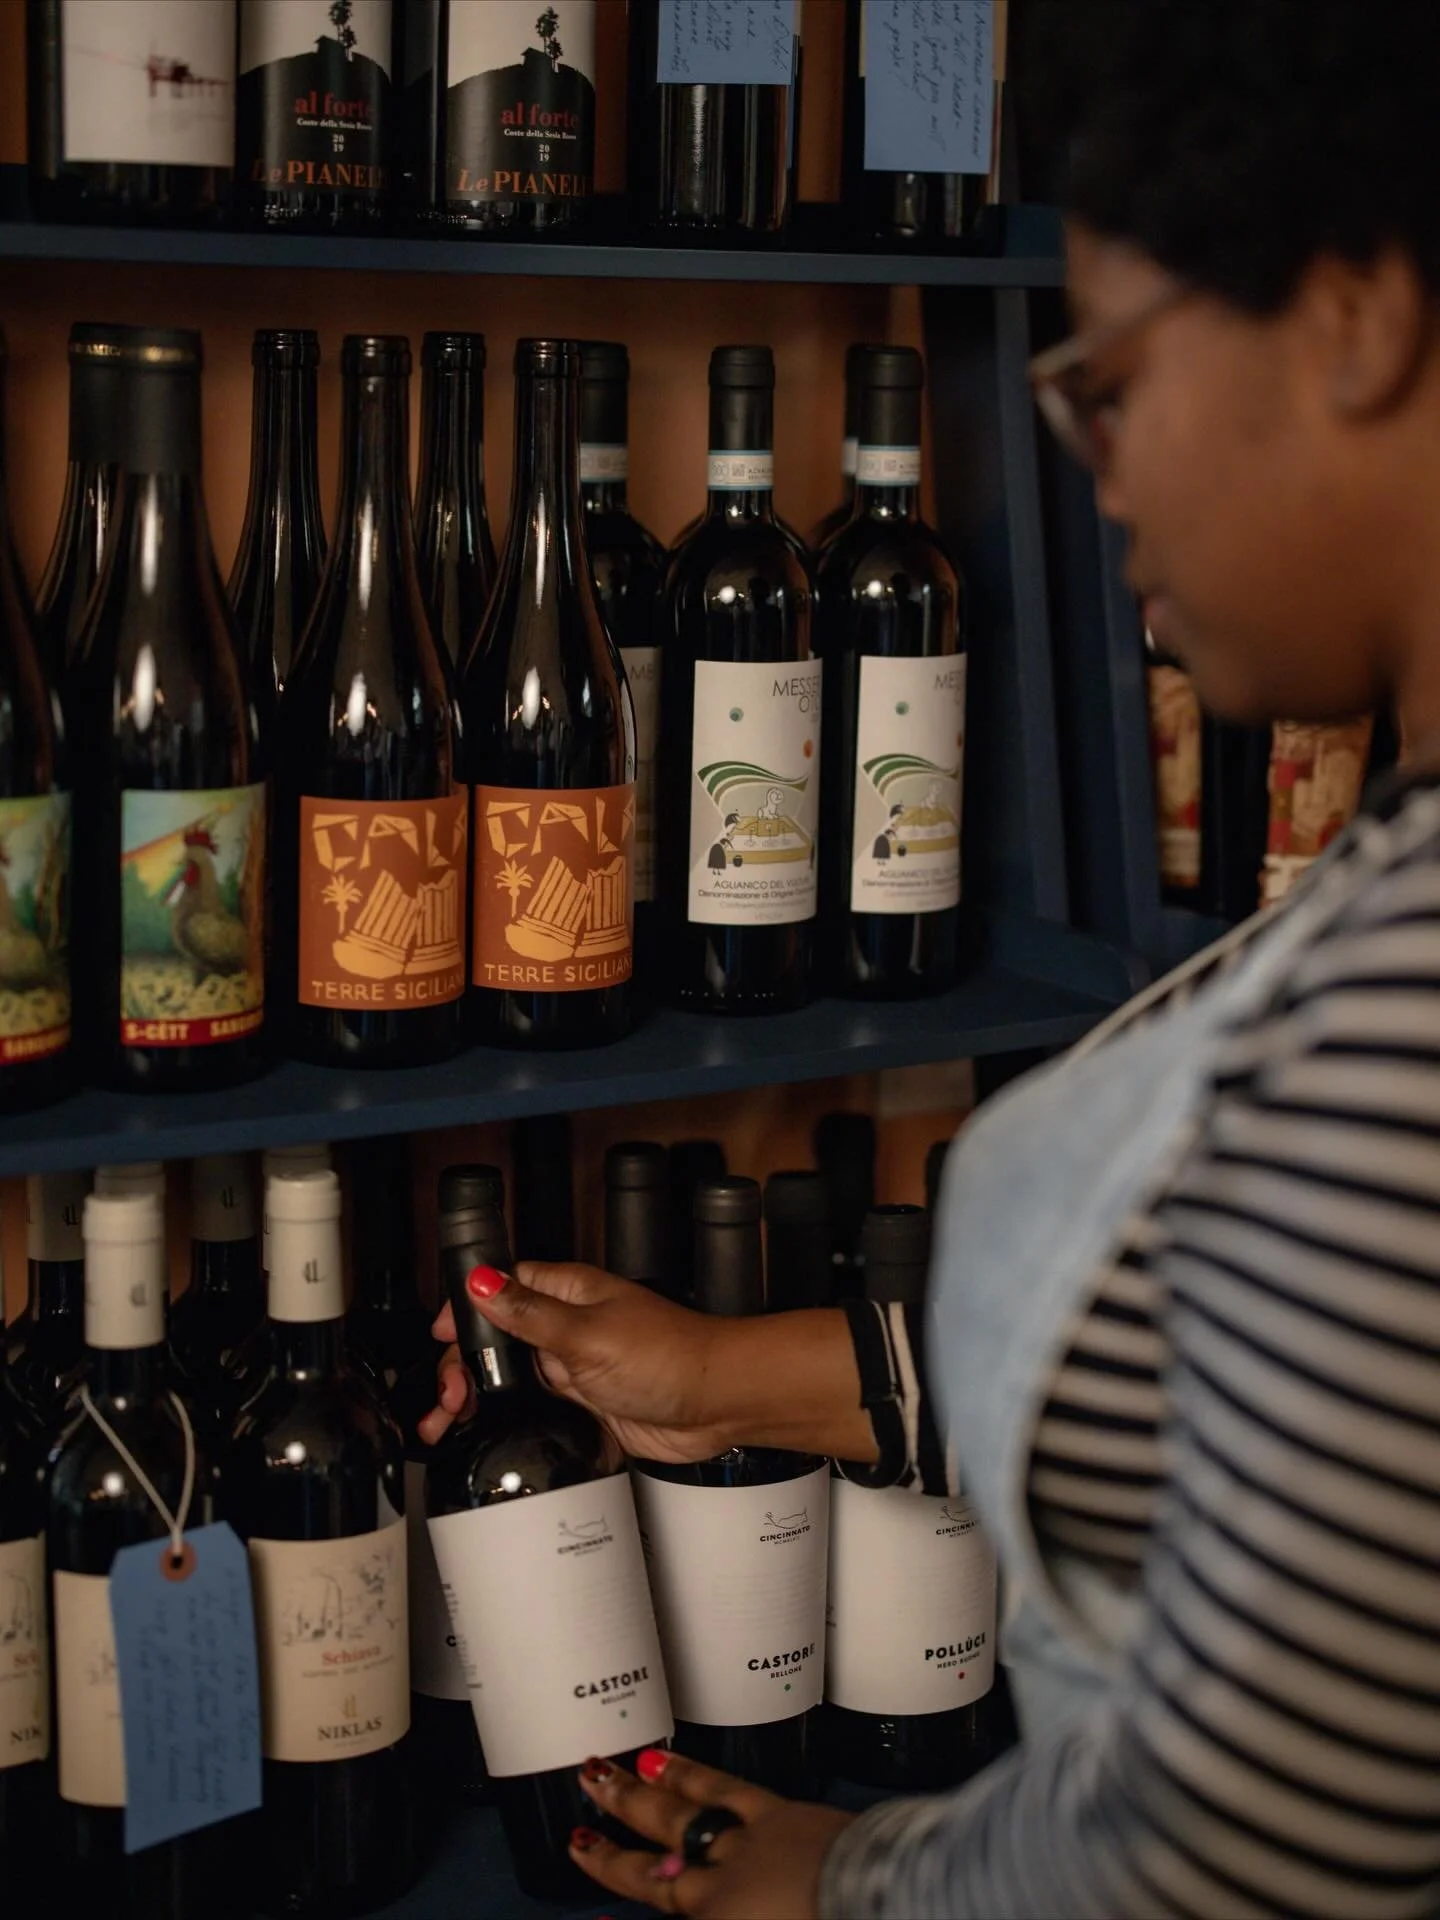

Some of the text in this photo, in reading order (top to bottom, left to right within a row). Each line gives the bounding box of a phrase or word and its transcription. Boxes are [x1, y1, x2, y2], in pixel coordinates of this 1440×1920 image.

[295, 89, 376, 118] al forte
[500, 100, 580, 129] al forte
[319, 119, 338, 128] della
[332, 133, 345, 143] 20
[526, 129, 544, 138] della
[333, 143, 345, 153] 19
[539, 143, 550, 153] 20
[539, 152, 550, 162] 19
[456, 168, 489, 192] Le
[714, 880, 769, 890] AGLIANICO
[484, 964, 556, 984] TERRE
[311, 981, 386, 1002] TERRE
[759, 1524, 811, 1542] CINCINNATO
[317, 1715, 384, 1742] NIKLAS
